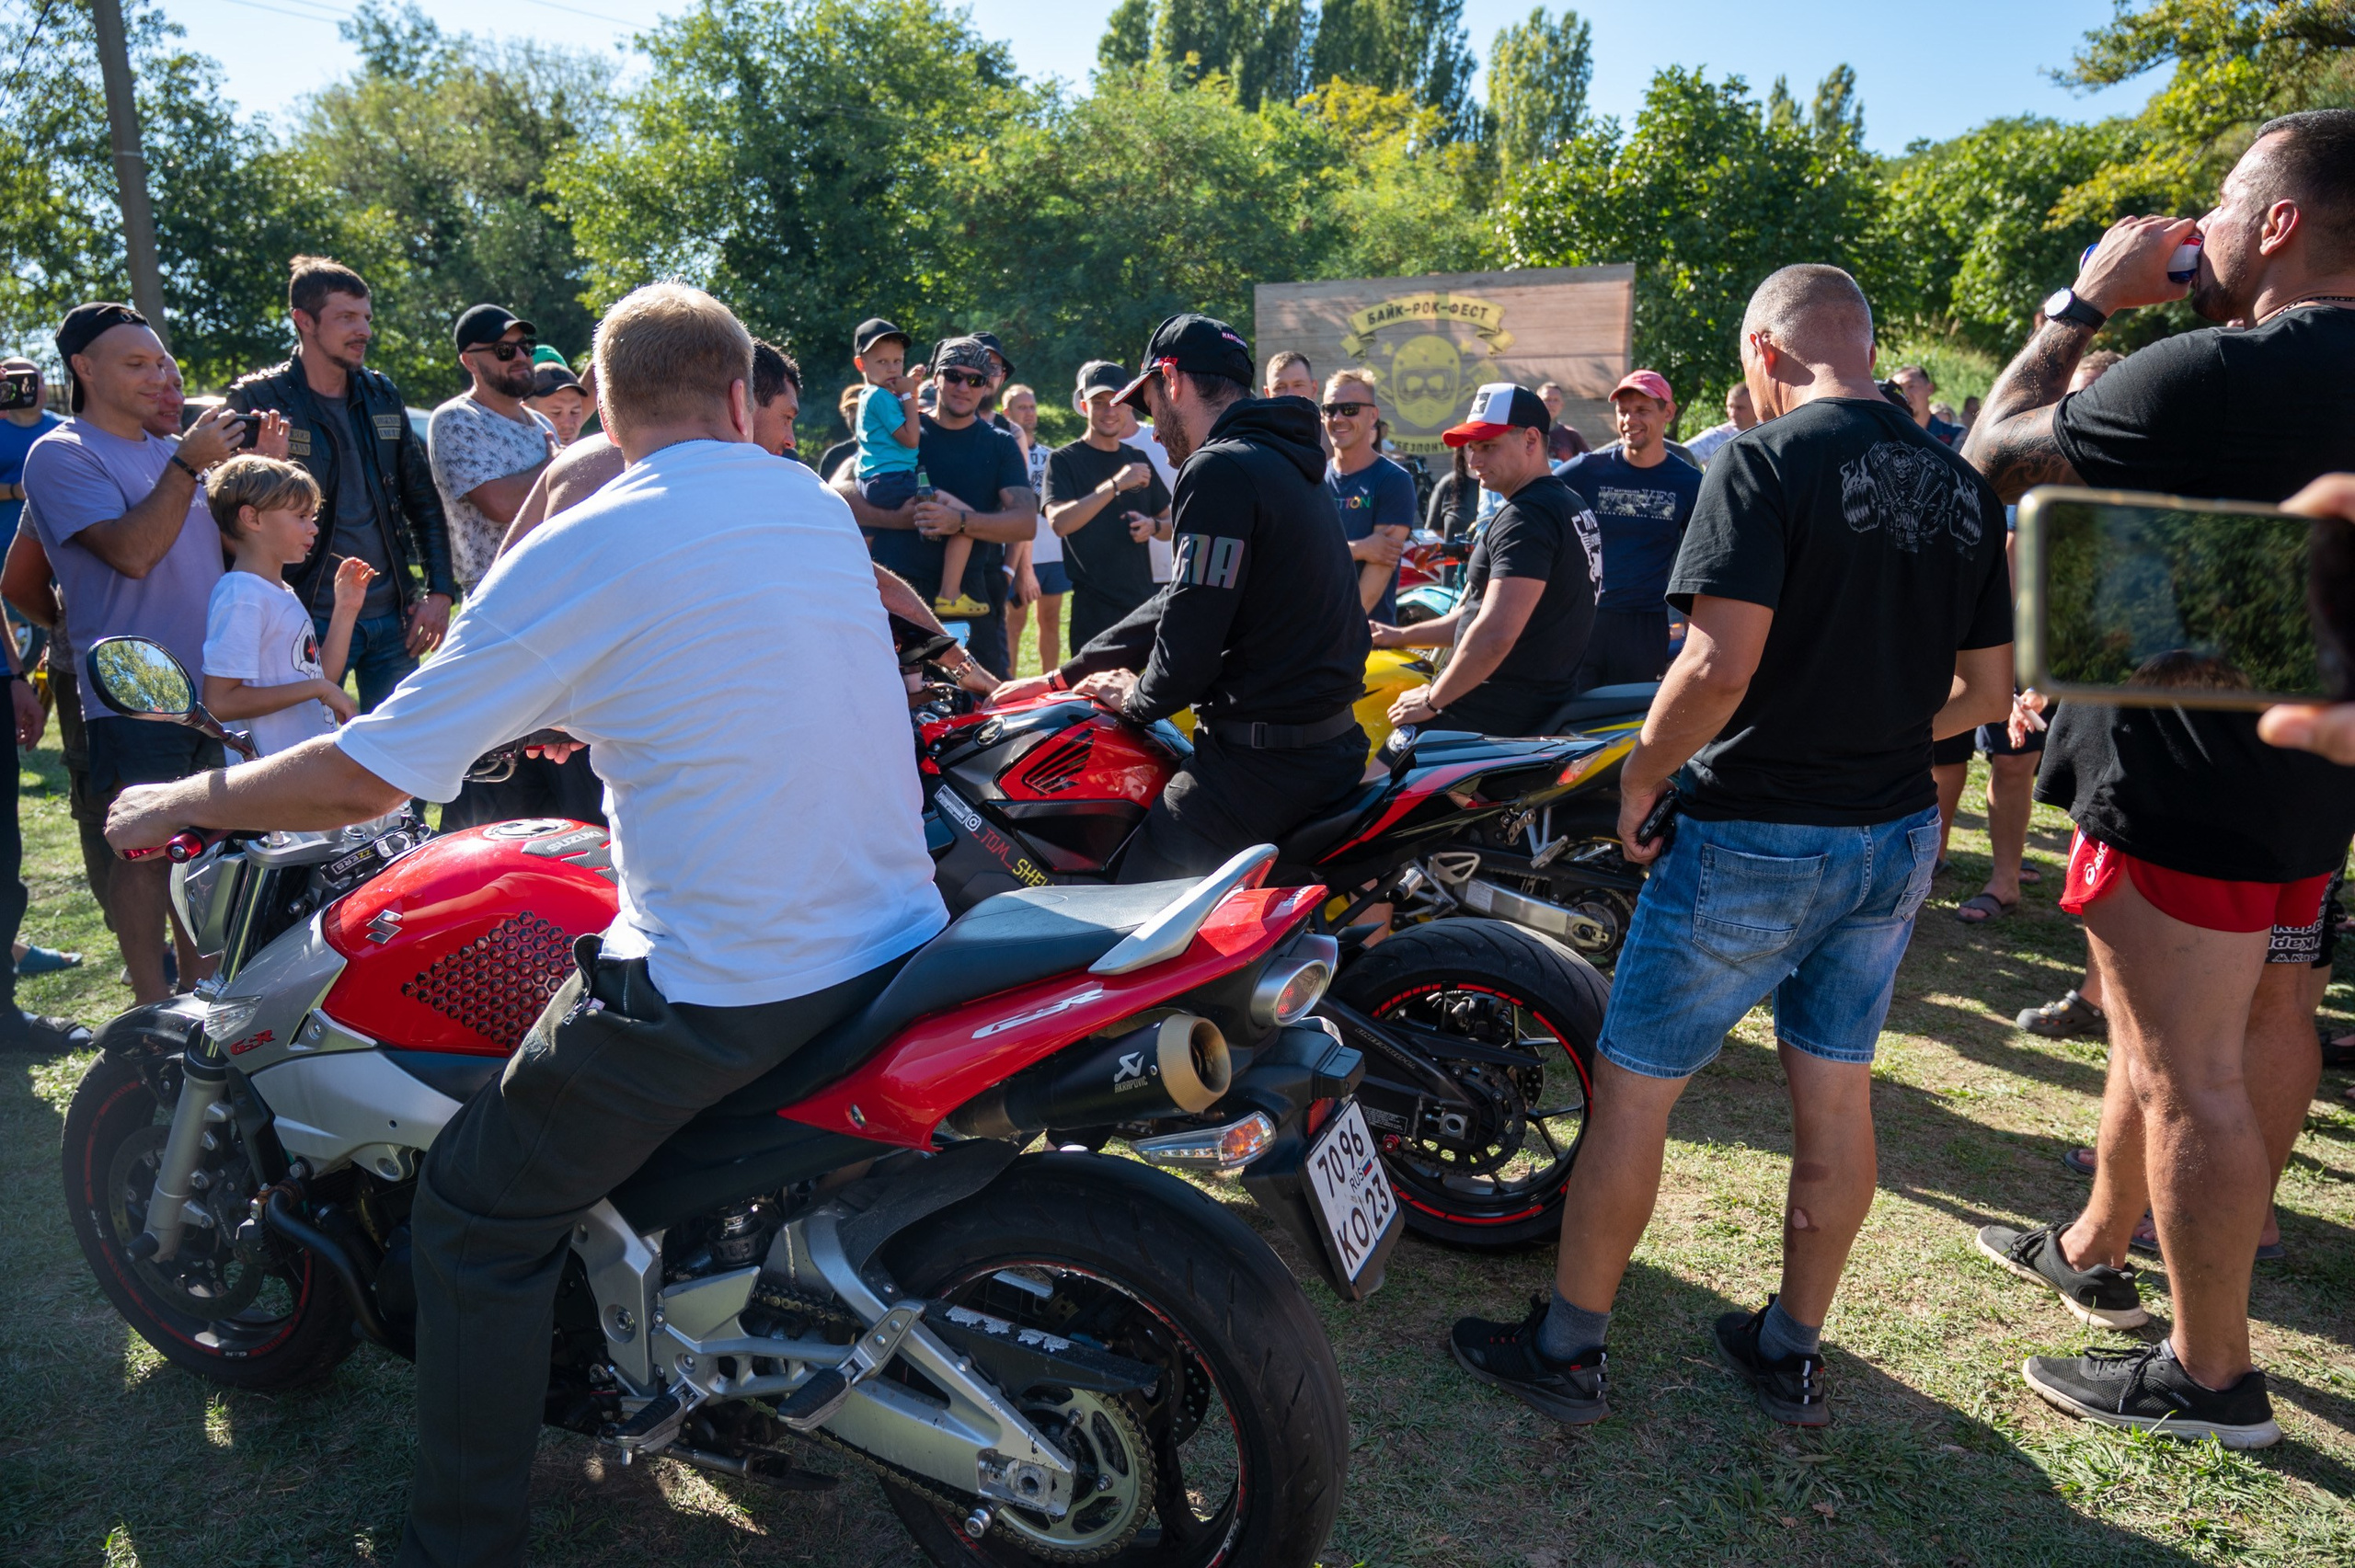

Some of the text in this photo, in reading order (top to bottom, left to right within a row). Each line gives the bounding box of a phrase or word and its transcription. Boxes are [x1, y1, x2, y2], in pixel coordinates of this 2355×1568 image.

[1367, 302, 1488, 325] БАЙК-РОК-ФЕСТ
[1396, 441, 1453, 453] БЕЗПОНТ
[1334, 496, 1371, 509] TTON
[546, 830, 604, 852] SUZUKI
[335, 848, 373, 871] ZZERS
[230, 1029, 276, 1055] GSR
[1317, 1118, 1364, 1198] 7096
[1349, 1167, 1365, 1193] RUS
[1364, 1173, 1390, 1230] 23
